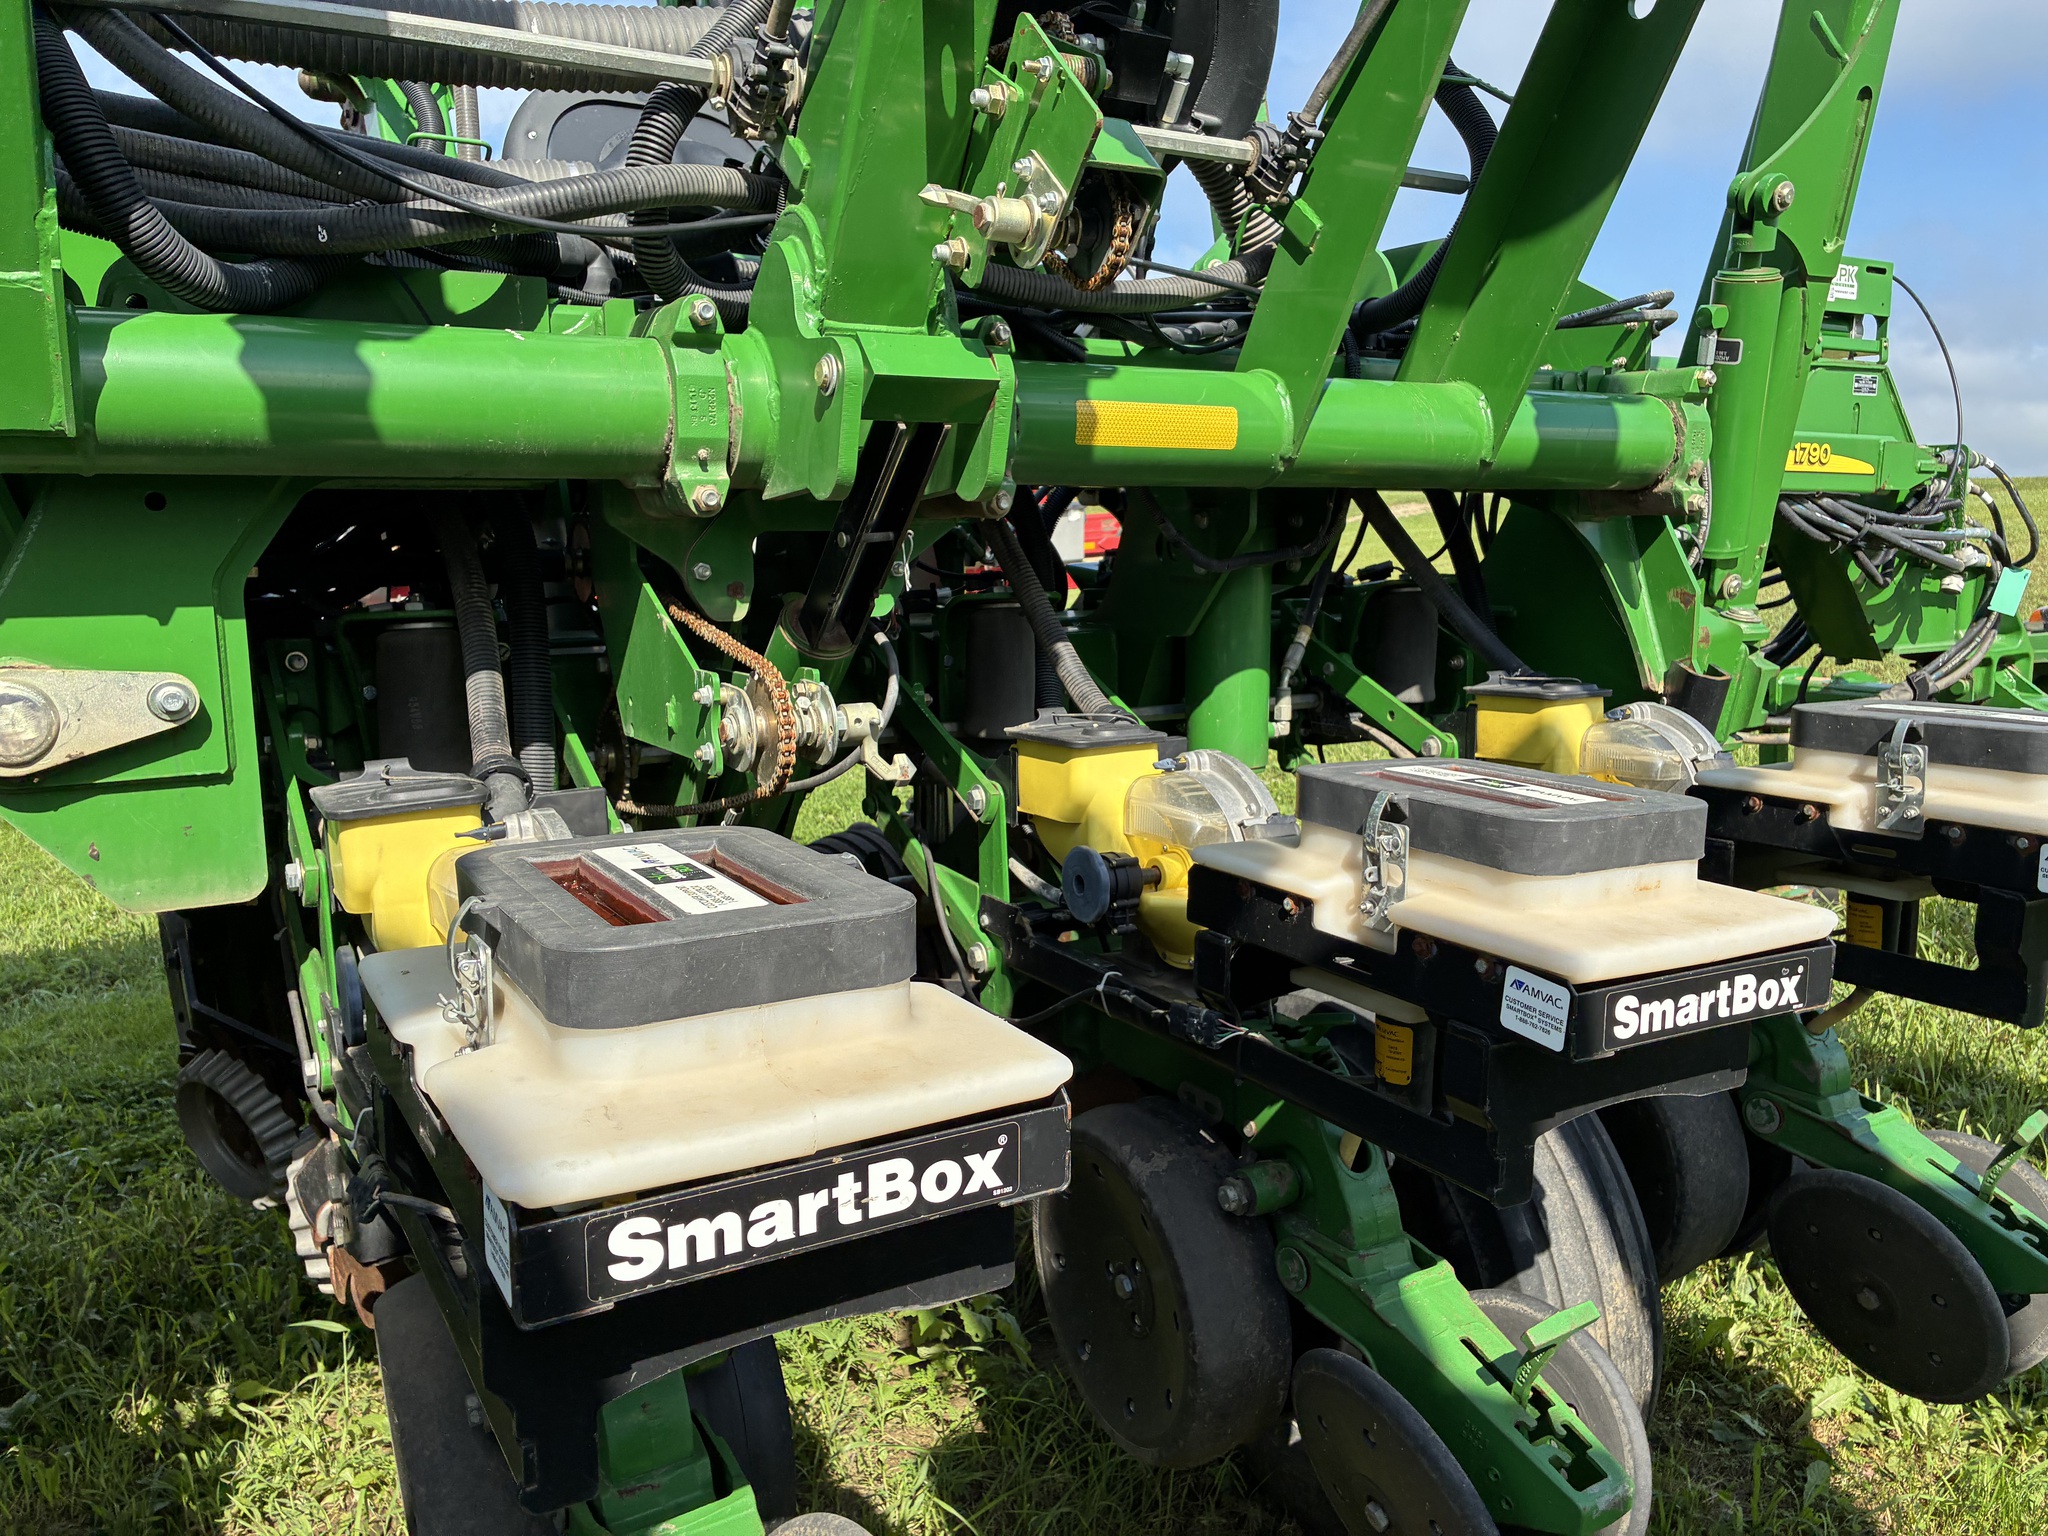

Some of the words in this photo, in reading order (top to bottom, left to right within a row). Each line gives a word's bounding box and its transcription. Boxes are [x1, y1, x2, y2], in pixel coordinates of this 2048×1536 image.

[1793, 442, 1831, 466] 1790
[1522, 984, 1563, 1010] AMVAC
[1504, 995, 1537, 1014] CUSTOMER
[1538, 1009, 1564, 1027] SERVICE
[1537, 1017, 1563, 1034] SYSTEMS
